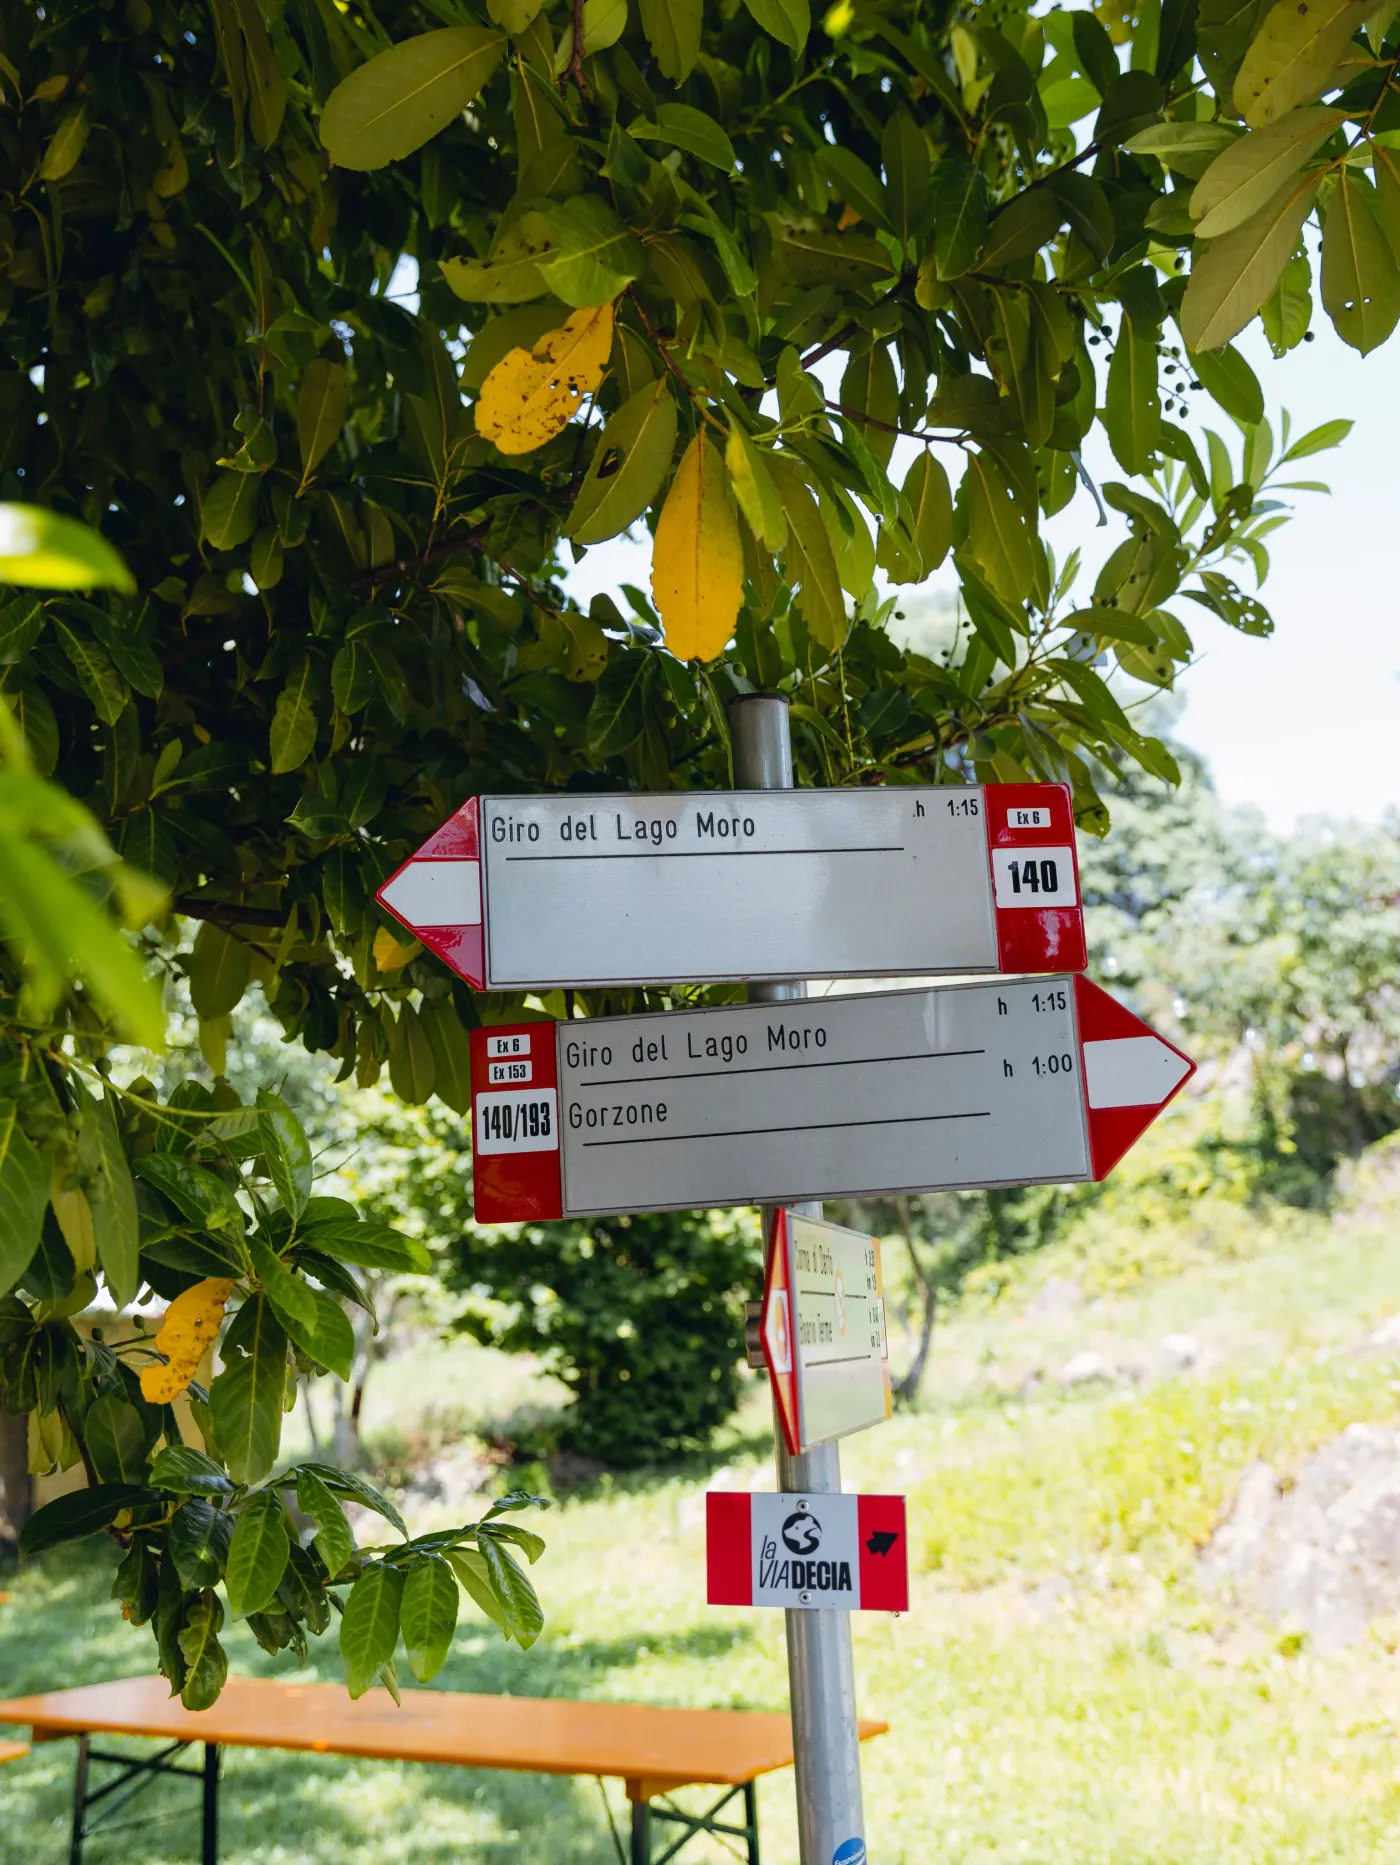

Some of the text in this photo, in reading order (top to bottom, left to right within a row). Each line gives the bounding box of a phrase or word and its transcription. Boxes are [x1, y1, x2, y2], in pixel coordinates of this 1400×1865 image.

[915, 798, 979, 818] h 1:15
[1016, 810, 1041, 825] Ex 6
[491, 811, 755, 846] Giro del Lago Moro
[1007, 860, 1059, 894] 140
[997, 991, 1067, 1016] h 1:15
[496, 1038, 520, 1054] Ex 6
[566, 1024, 827, 1069] Giro del Lago Moro
[493, 1063, 527, 1080] Ex 153
[1003, 1053, 1073, 1078] h 1:00
[482, 1101, 551, 1142] 140/193
[568, 1102, 668, 1129] Gorzone
[760, 1534, 778, 1560] la
